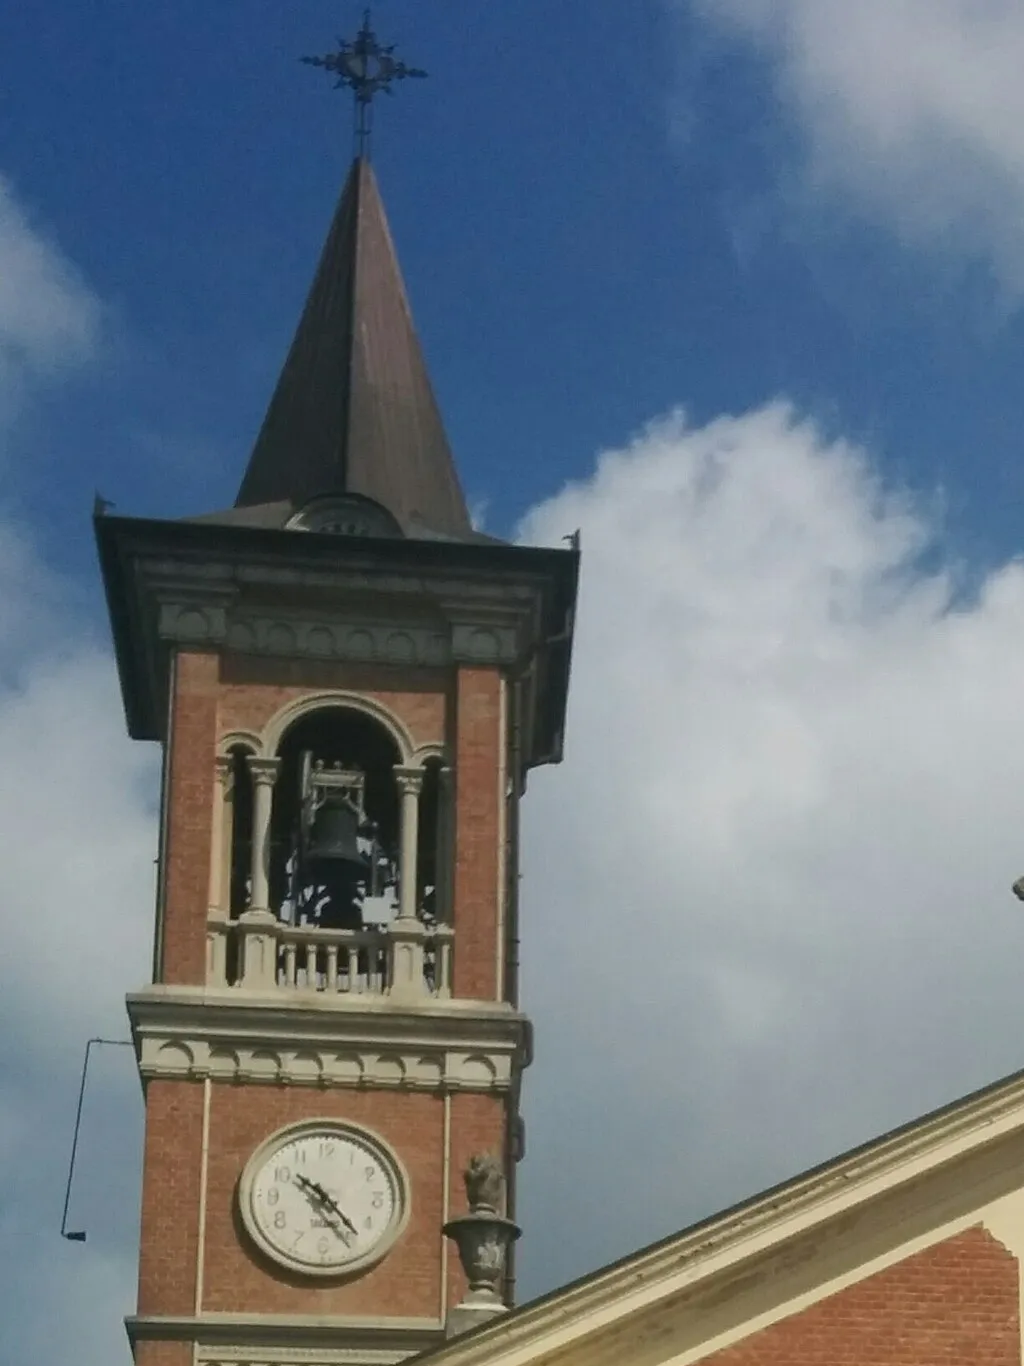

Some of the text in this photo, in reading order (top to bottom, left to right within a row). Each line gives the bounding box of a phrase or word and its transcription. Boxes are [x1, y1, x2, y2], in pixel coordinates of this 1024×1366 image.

[294, 1150, 306, 1165] 11
[318, 1143, 335, 1159] 12
[274, 1165, 291, 1184] 10
[364, 1166, 375, 1183] 2
[267, 1187, 280, 1206] 9
[371, 1191, 384, 1209] 3
[274, 1210, 287, 1230] 8
[363, 1215, 373, 1230] 4
[293, 1230, 305, 1246] 7
[316, 1236, 329, 1255] 6
